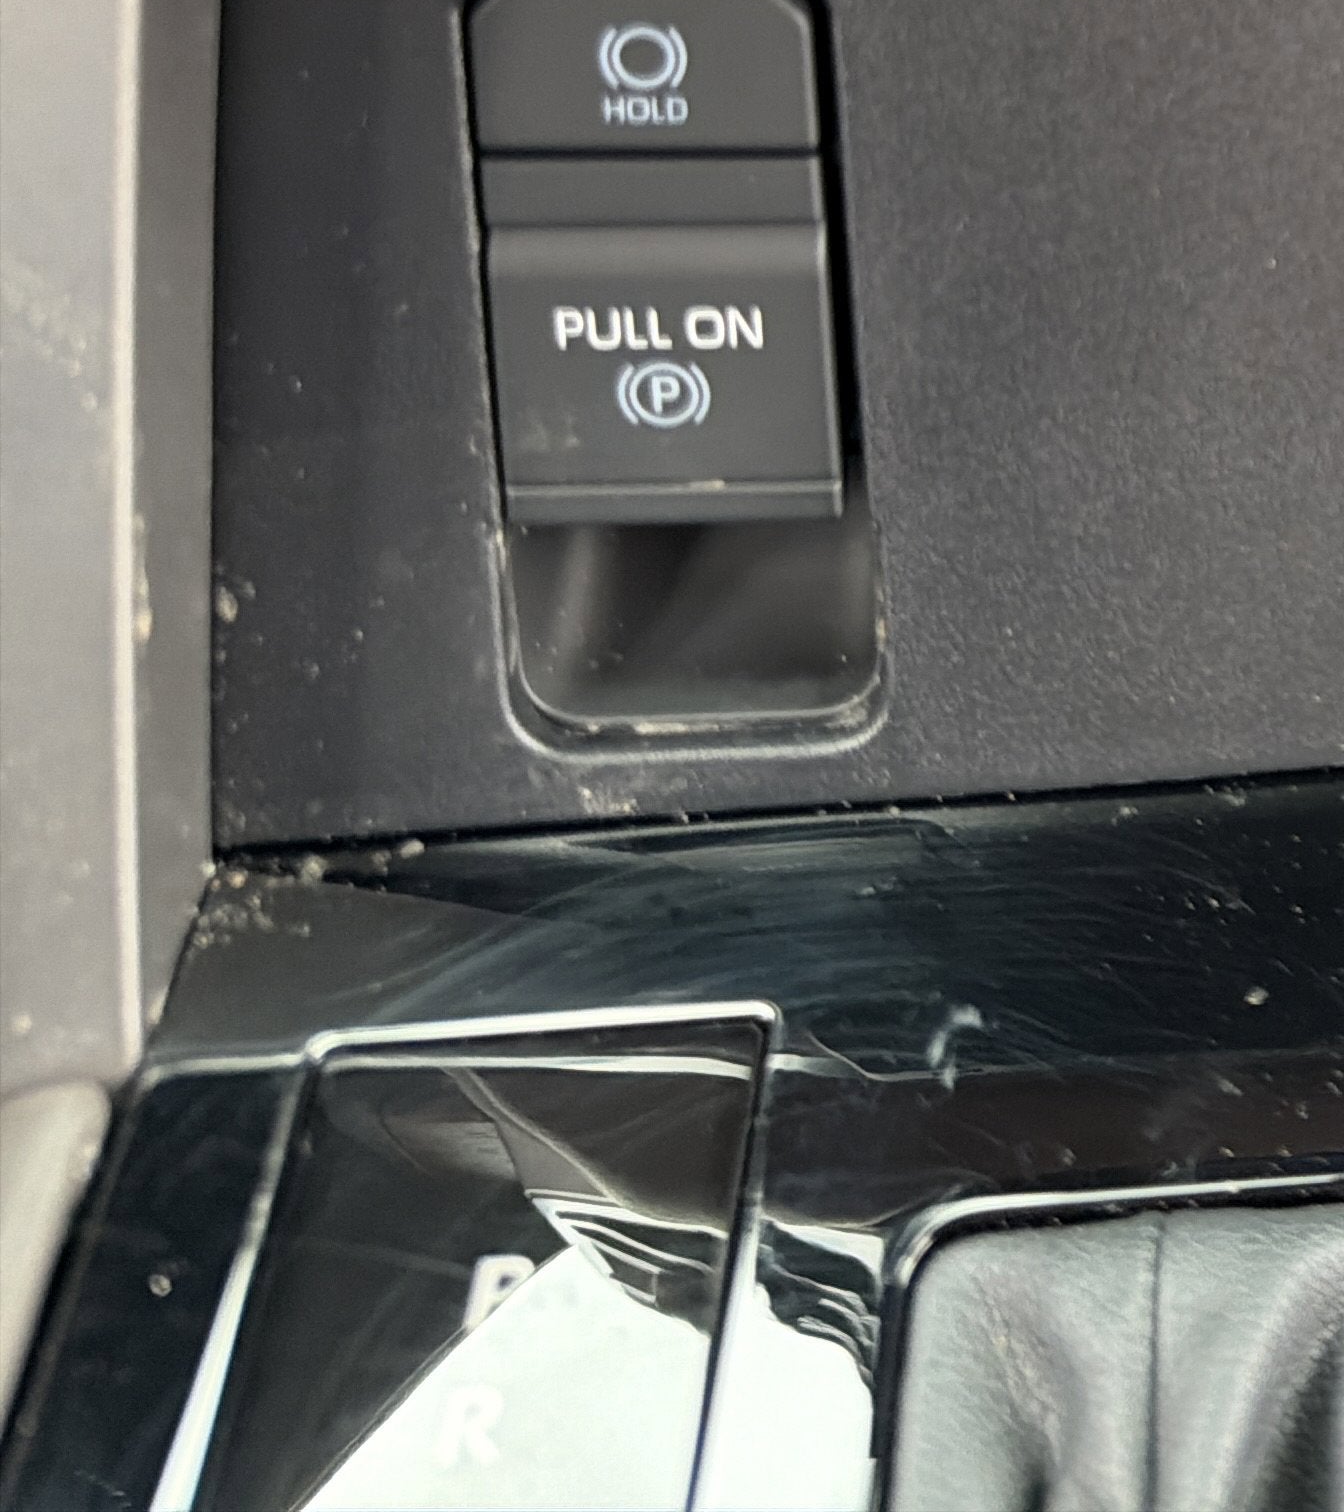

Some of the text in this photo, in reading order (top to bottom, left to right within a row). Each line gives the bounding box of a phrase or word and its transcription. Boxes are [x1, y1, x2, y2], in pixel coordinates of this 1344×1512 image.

[603, 95, 688, 124] HOLD
[553, 305, 764, 351] PULL ON
